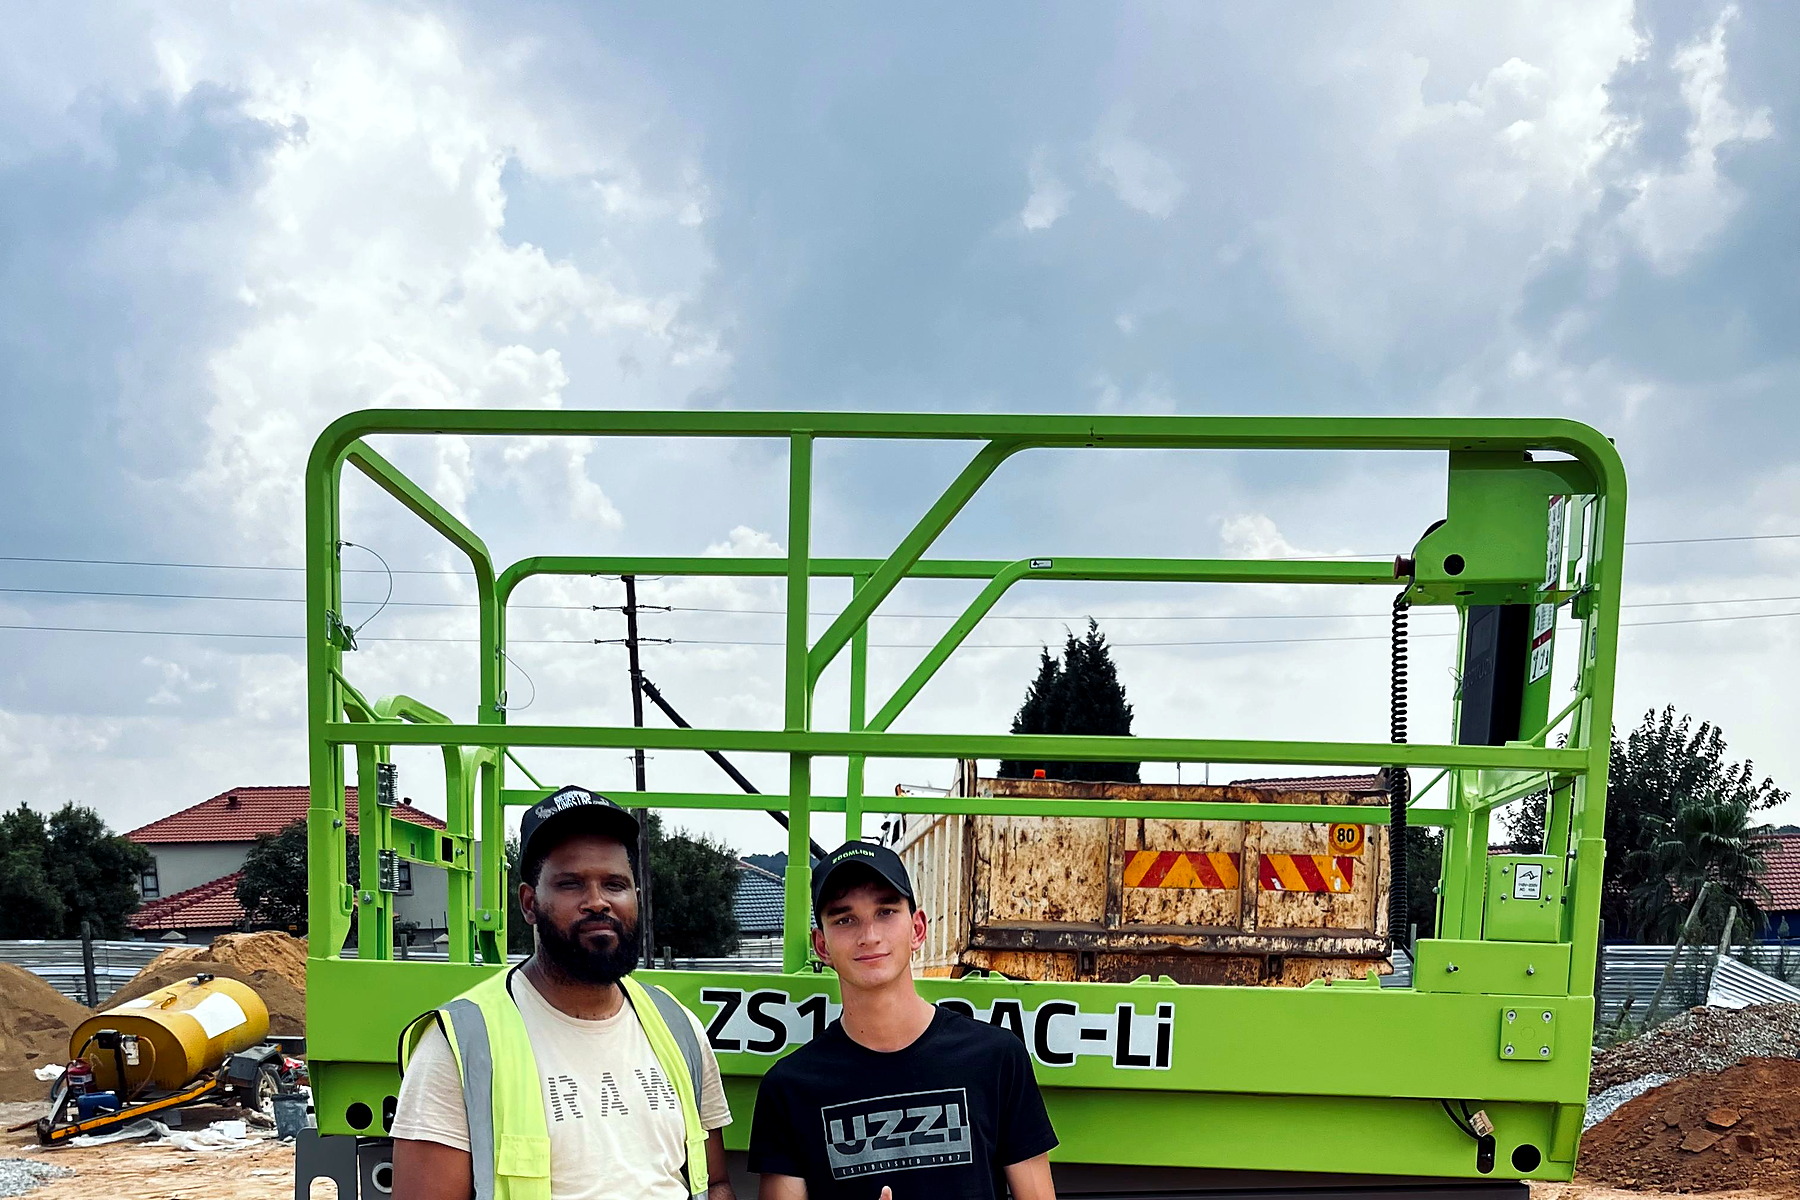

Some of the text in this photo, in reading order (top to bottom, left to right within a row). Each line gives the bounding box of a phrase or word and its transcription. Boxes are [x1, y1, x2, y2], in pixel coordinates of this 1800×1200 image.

[1337, 828, 1355, 843] 80
[547, 1067, 675, 1122] RAW
[829, 1103, 962, 1156] UZZI
[932, 1153, 961, 1164] 1987
